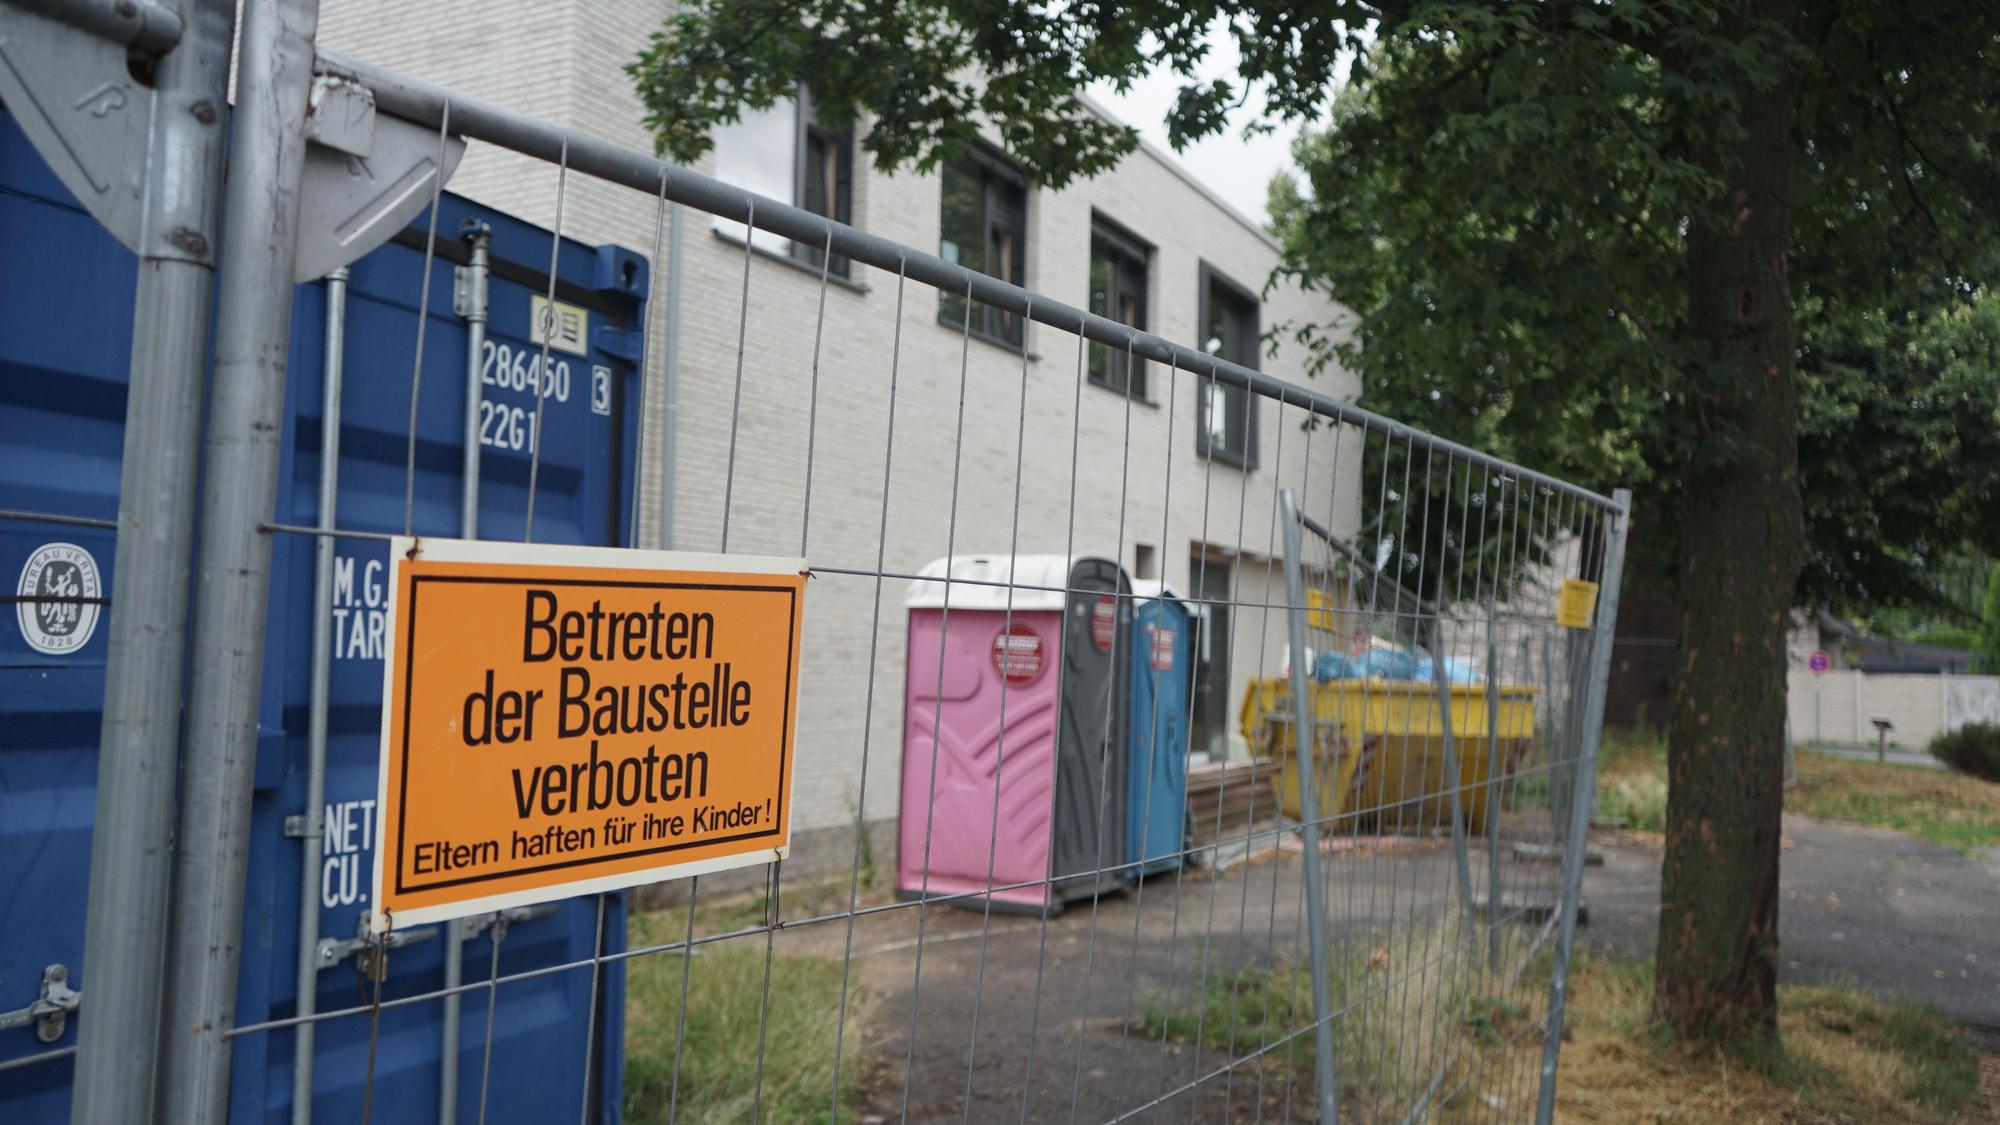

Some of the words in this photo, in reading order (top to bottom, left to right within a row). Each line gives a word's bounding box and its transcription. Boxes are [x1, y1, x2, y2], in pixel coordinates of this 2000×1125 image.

[481, 340, 570, 402] 286450
[595, 370, 609, 410] 3
[479, 400, 537, 454] 22G1
[65, 550, 95, 597] VERITA
[333, 556, 388, 608] M.G.
[333, 608, 388, 660] TAR
[523, 589, 714, 663] Betreten
[462, 669, 543, 747] der
[557, 662, 751, 739] Baustelle
[511, 740, 709, 820] verboten
[324, 800, 375, 854] NET
[413, 840, 499, 875] Eltern
[511, 824, 595, 860] haften
[603, 818, 636, 849] für
[642, 812, 685, 841] ihre
[322, 854, 367, 908] CU.
